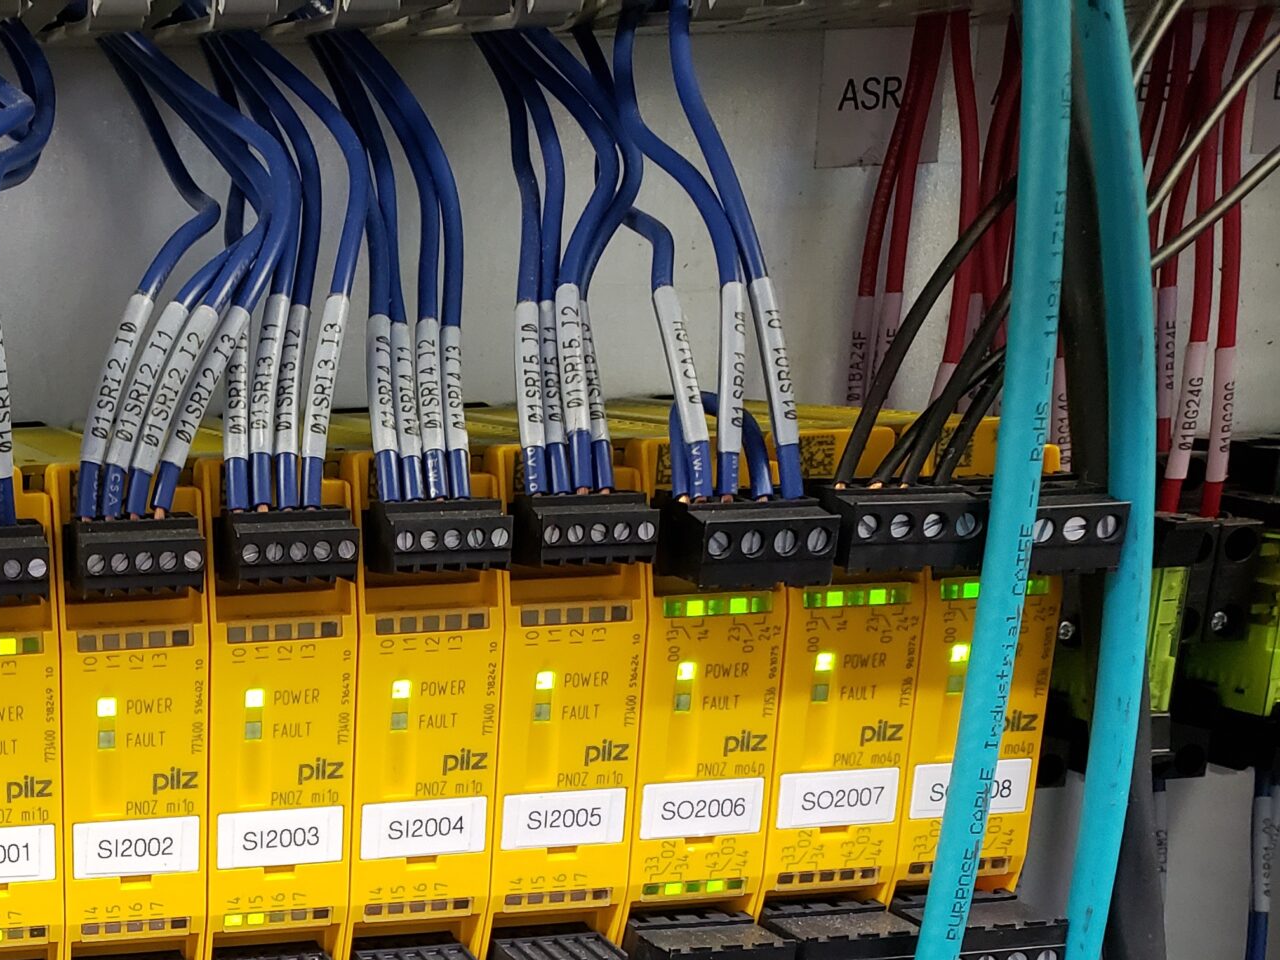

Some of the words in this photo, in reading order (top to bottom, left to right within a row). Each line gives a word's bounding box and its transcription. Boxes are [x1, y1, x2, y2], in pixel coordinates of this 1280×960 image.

[843, 652, 887, 670] POWER
[563, 671, 610, 688] POWER
[704, 662, 750, 679] POWER
[273, 688, 321, 706] POWER
[420, 679, 467, 697] POWER
[840, 684, 877, 701] FAULT
[125, 697, 173, 715] POWER
[702, 694, 741, 711] FAULT
[418, 712, 458, 729] FAULT
[561, 704, 600, 721] FAULT
[272, 721, 313, 739] FAULT
[859, 719, 904, 747] pilz
[125, 731, 166, 748] FAULT
[723, 729, 768, 757] pilz
[442, 747, 489, 776] pilz
[584, 738, 630, 767] pilz
[833, 752, 863, 766] PNOZ
[297, 757, 345, 786] pilz
[696, 763, 727, 777] PNOZ
[6, 774, 53, 803] pilz
[152, 766, 199, 795] pilz
[414, 781, 448, 797] PNOZ
[556, 772, 590, 788] PNOZ
[270, 790, 303, 806] PNOZ
[801, 786, 885, 811] SO2007
[125, 800, 158, 816] PNOZ
[661, 797, 746, 821] SO2006
[387, 815, 465, 840] SI2004
[526, 807, 602, 831] SI2005
[96, 836, 175, 860] SI2002
[242, 826, 320, 852] SI2003
